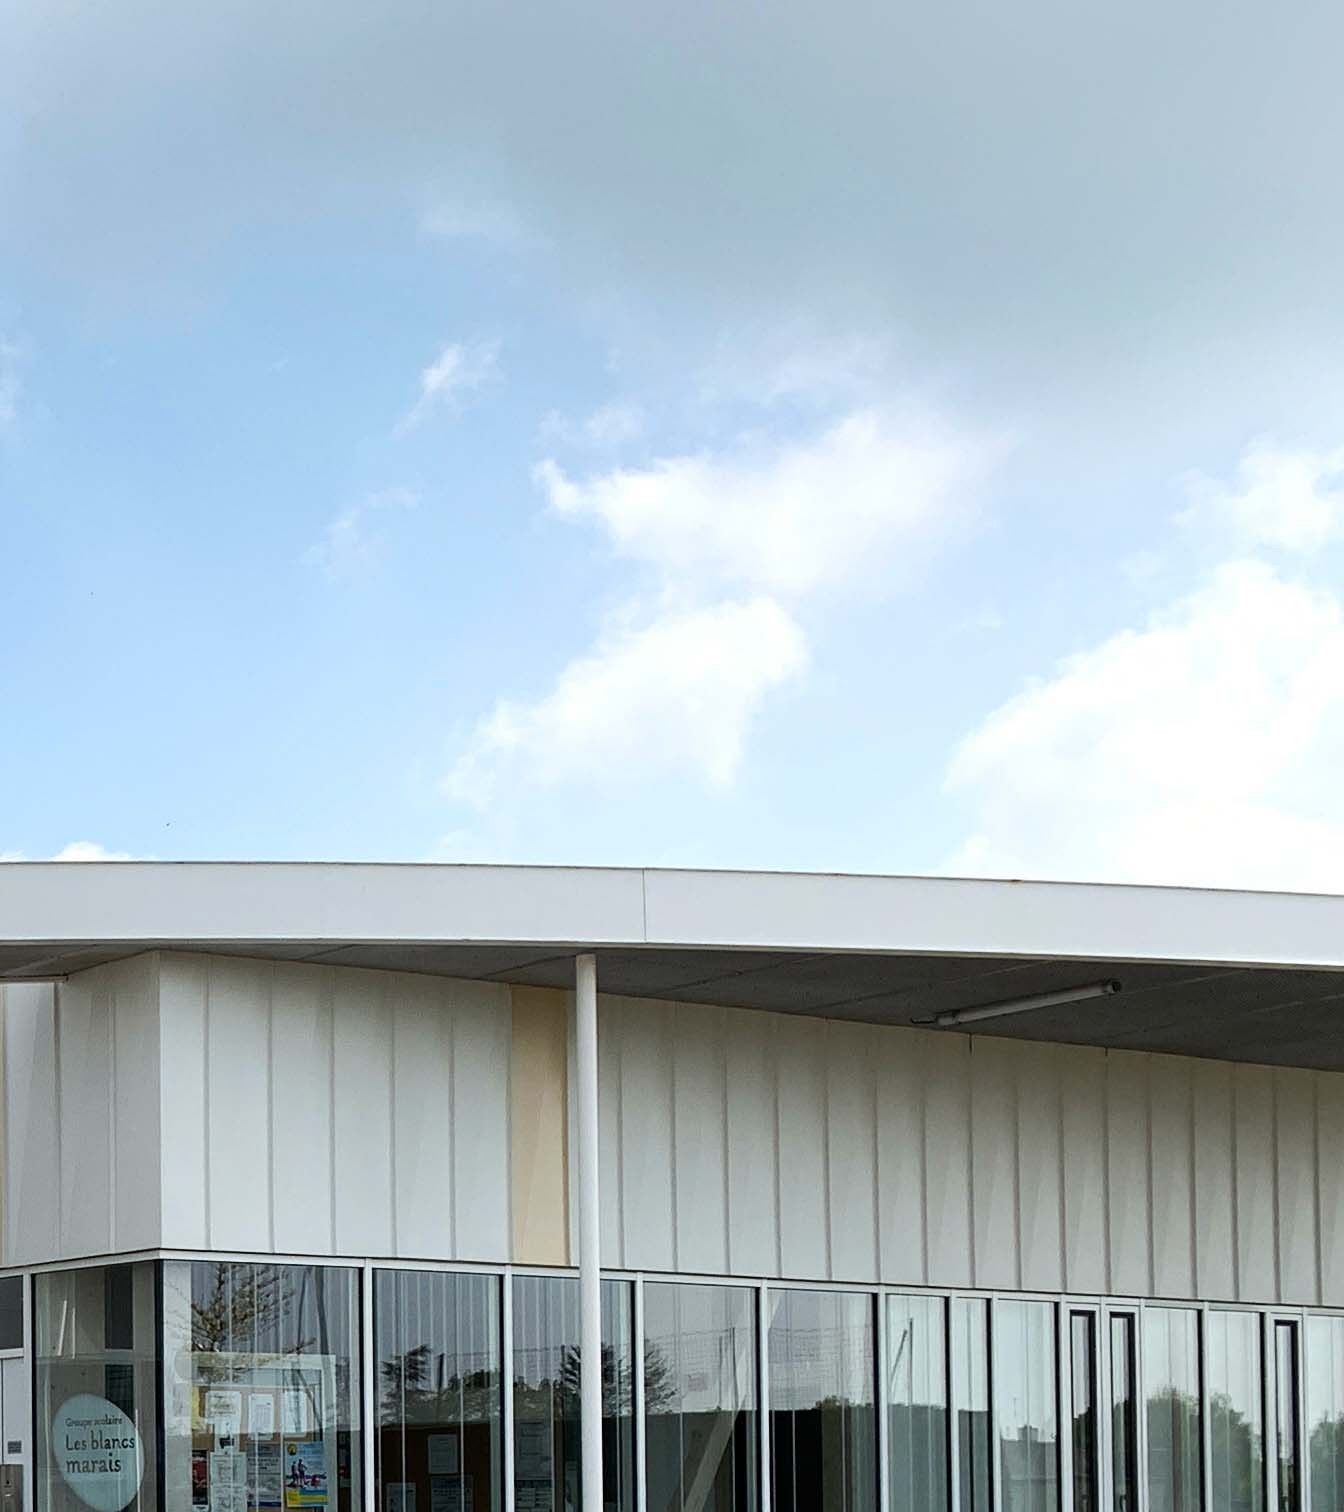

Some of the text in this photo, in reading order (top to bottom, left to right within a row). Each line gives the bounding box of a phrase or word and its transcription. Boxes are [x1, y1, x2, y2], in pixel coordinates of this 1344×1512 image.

[65, 1430, 135, 1451] Les blancs
[66, 1452, 122, 1473] marais
